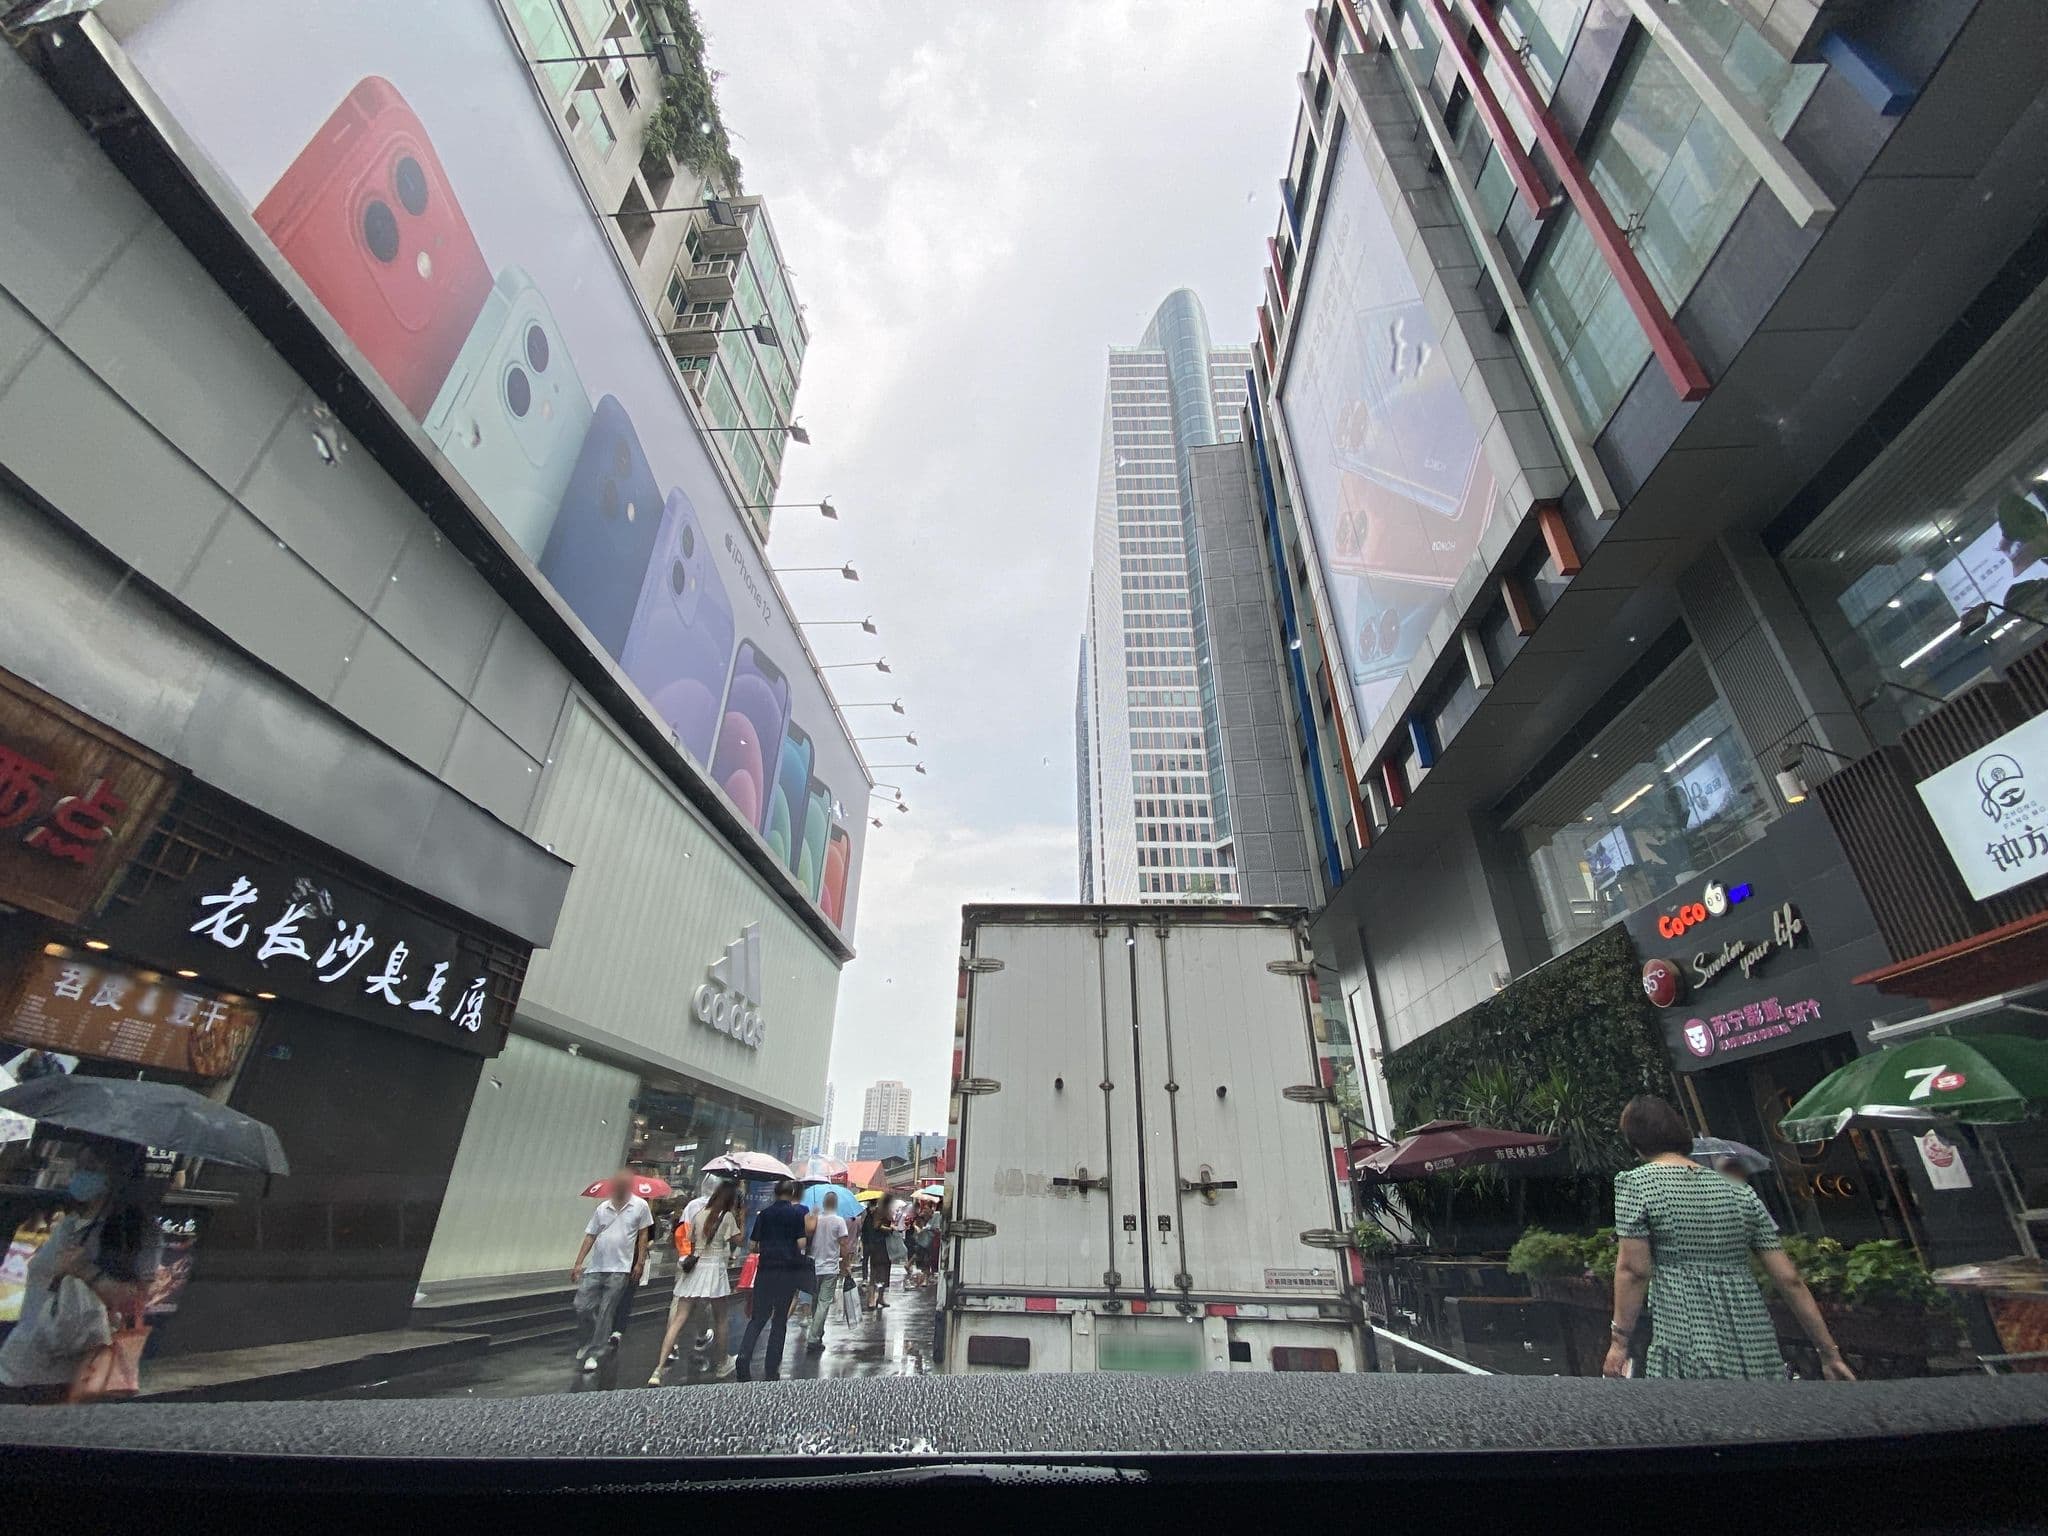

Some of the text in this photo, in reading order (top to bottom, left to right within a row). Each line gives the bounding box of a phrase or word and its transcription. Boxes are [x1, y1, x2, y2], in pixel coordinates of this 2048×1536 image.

[731, 543, 771, 627] iPhone 12
[190, 876, 486, 1033] 老长沙臭豆腐
[1693, 902, 1802, 989] Sweeten your life
[691, 983, 766, 1050] adidas
